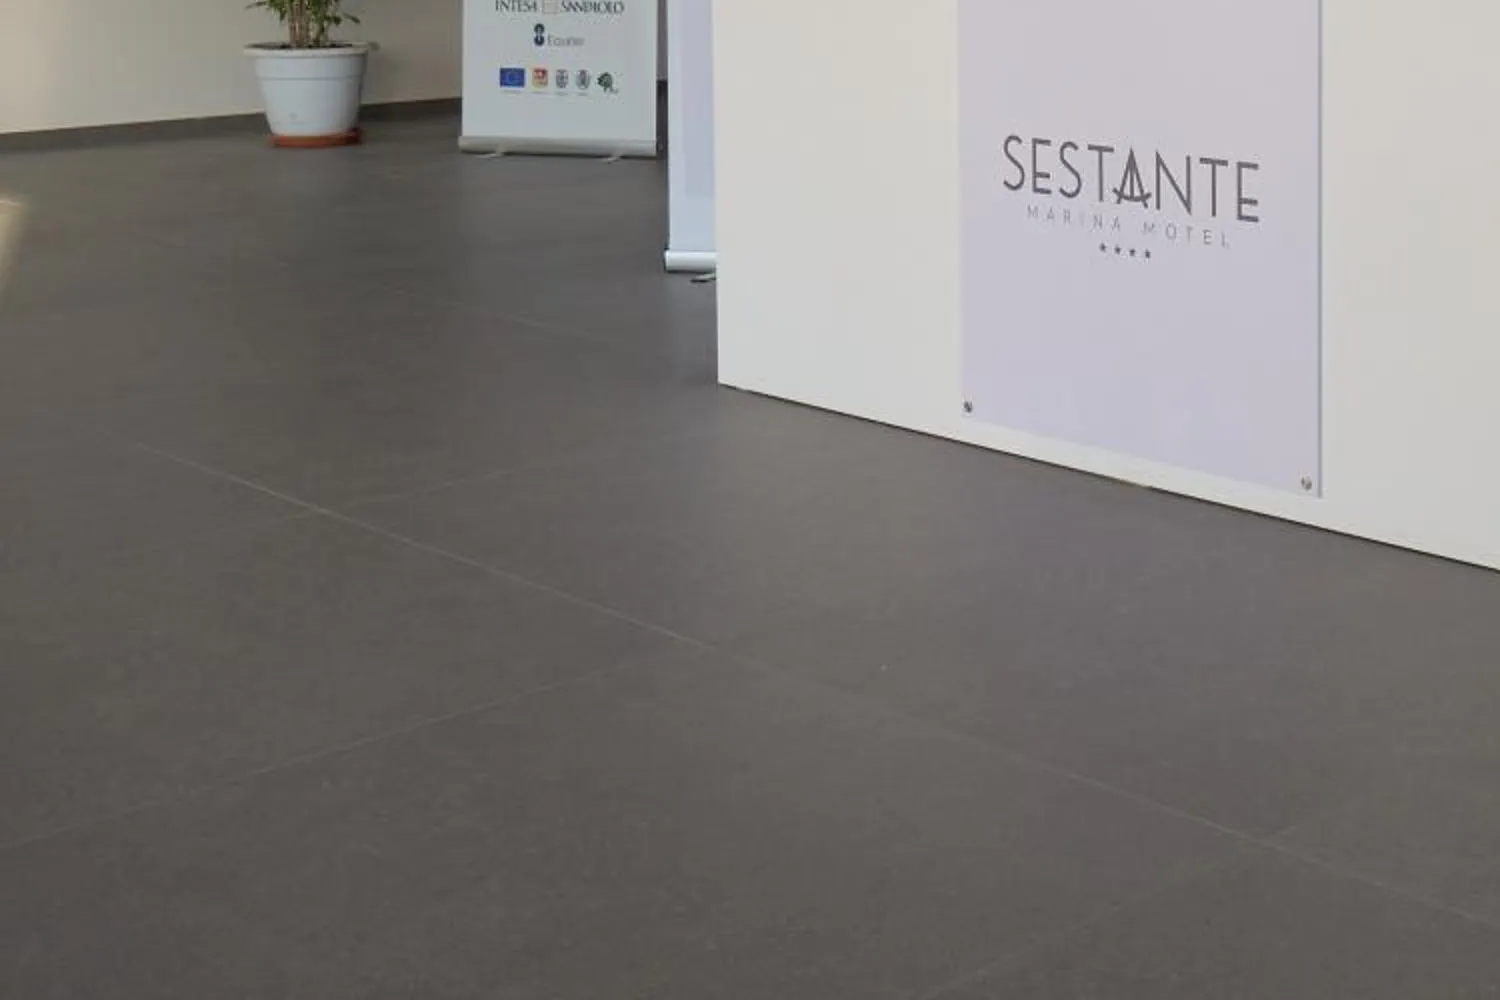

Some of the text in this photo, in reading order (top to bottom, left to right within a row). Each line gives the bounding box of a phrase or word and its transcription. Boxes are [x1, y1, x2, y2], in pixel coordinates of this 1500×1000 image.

[495, 0, 537, 14] INTESA
[1002, 133, 1259, 223] SESTANTE
[1026, 203, 1231, 249] MARINA MOTEL
